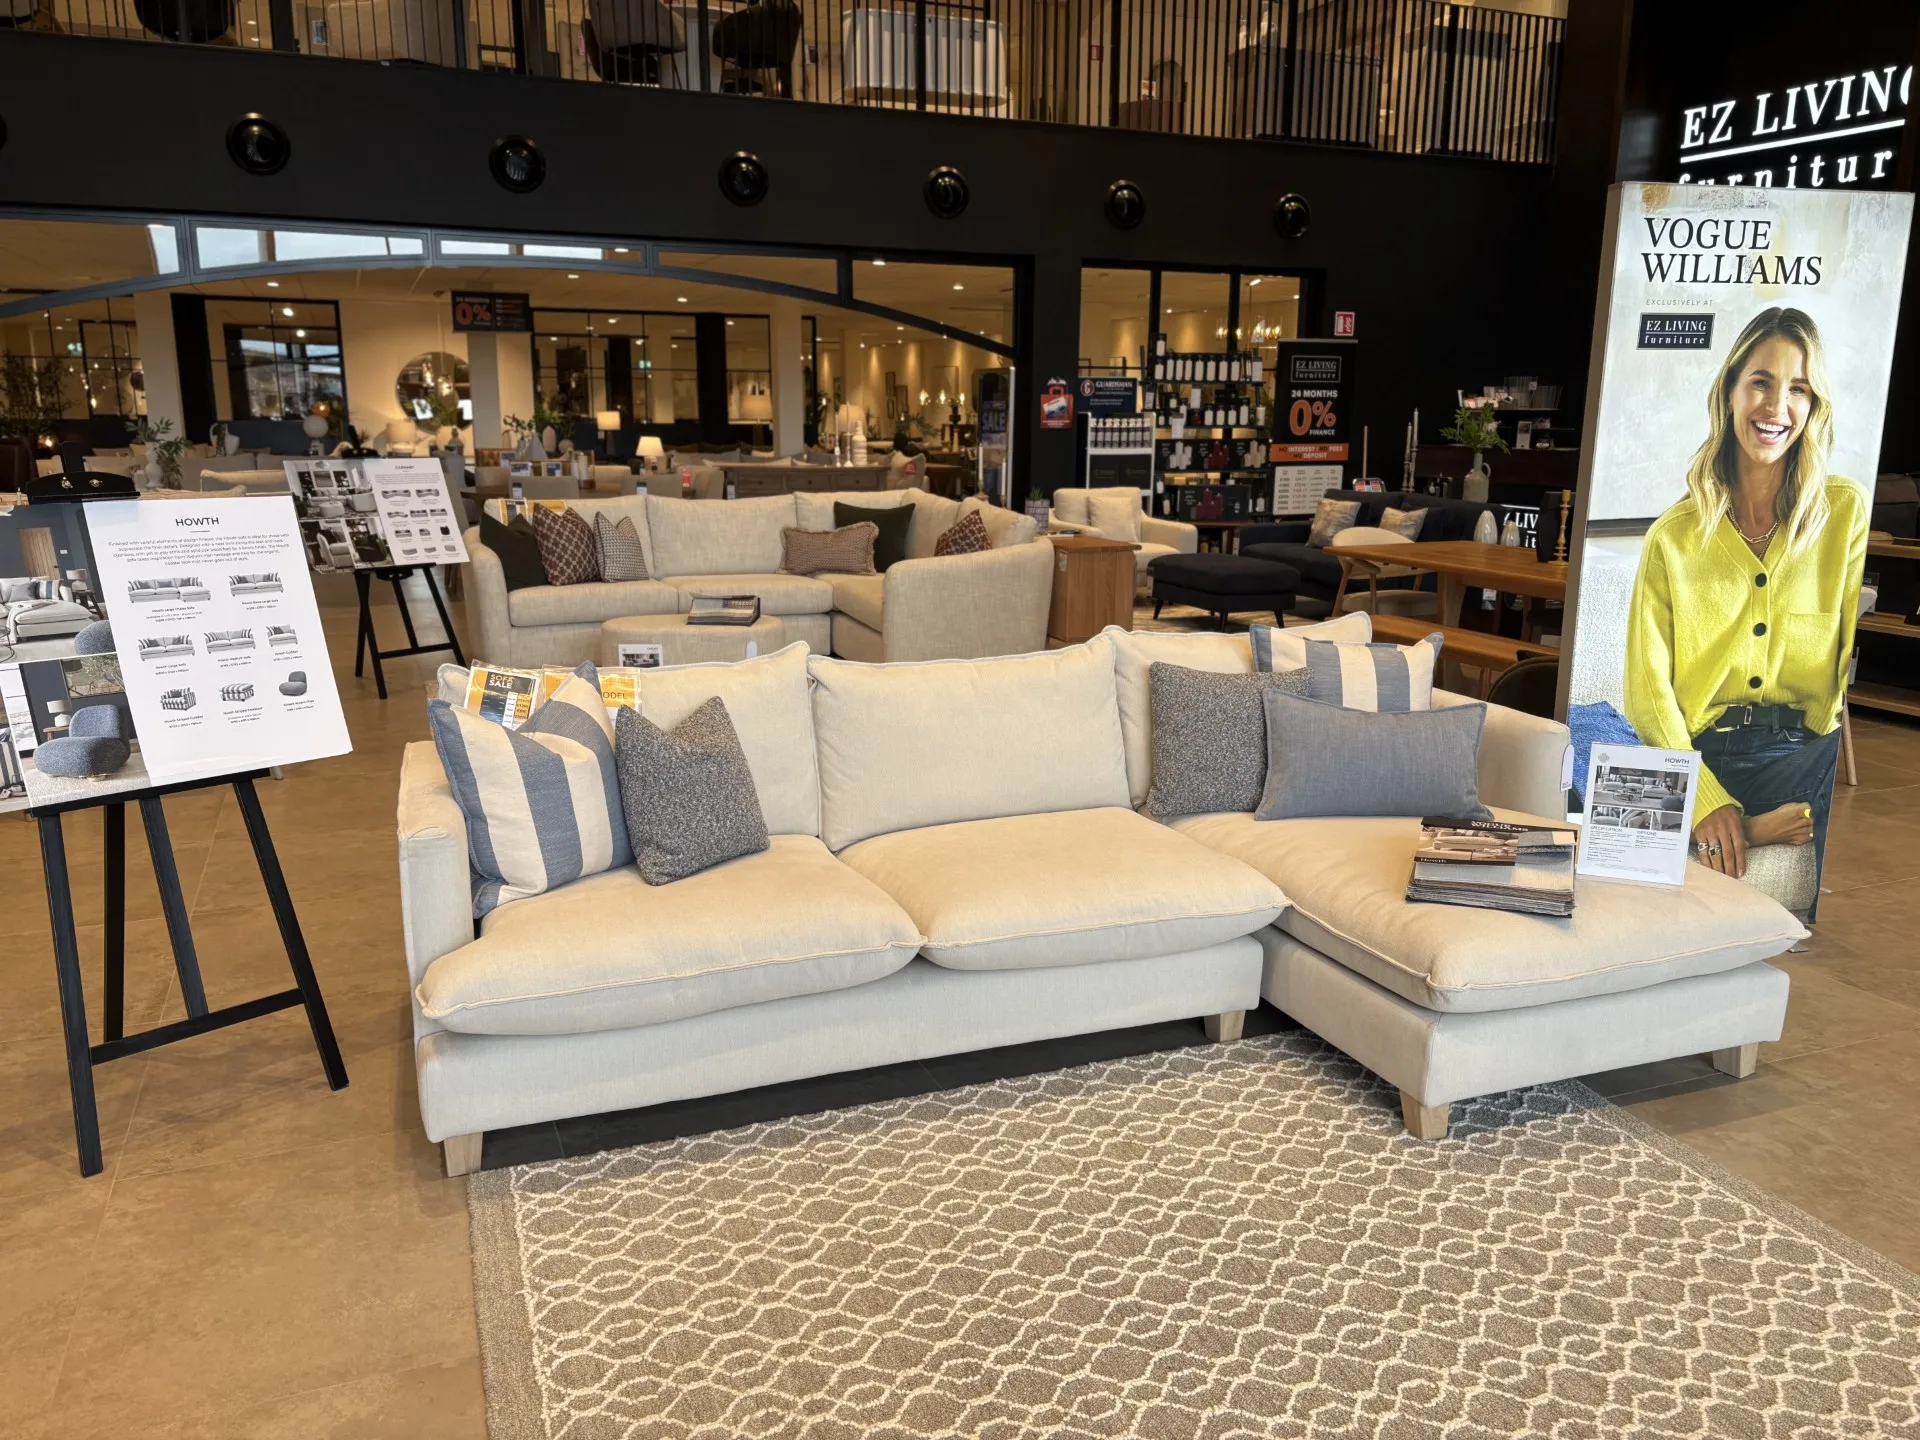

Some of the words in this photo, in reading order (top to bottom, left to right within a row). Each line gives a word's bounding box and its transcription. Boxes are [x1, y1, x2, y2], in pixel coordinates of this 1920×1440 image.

[1680, 100, 1735, 149] EZ
[1644, 217, 1771, 250] VOGUE
[1641, 252, 1823, 286] WILLIAMS
[1645, 299, 1701, 307] EXCLUSIVELY
[1645, 320, 1661, 331] EZ
[1665, 320, 1707, 332] LIVING
[1644, 334, 1705, 345] furniture
[1296, 360, 1306, 368] EZ
[1308, 361, 1337, 369] LIVING
[1290, 400, 1336, 436] 0%
[175, 517, 220, 526] HOWTH
[490, 674, 514, 684] SOFA
[488, 680, 512, 690] SALE
[601, 691, 628, 700] ODEL
[1664, 757, 1690, 765] HOWTH
